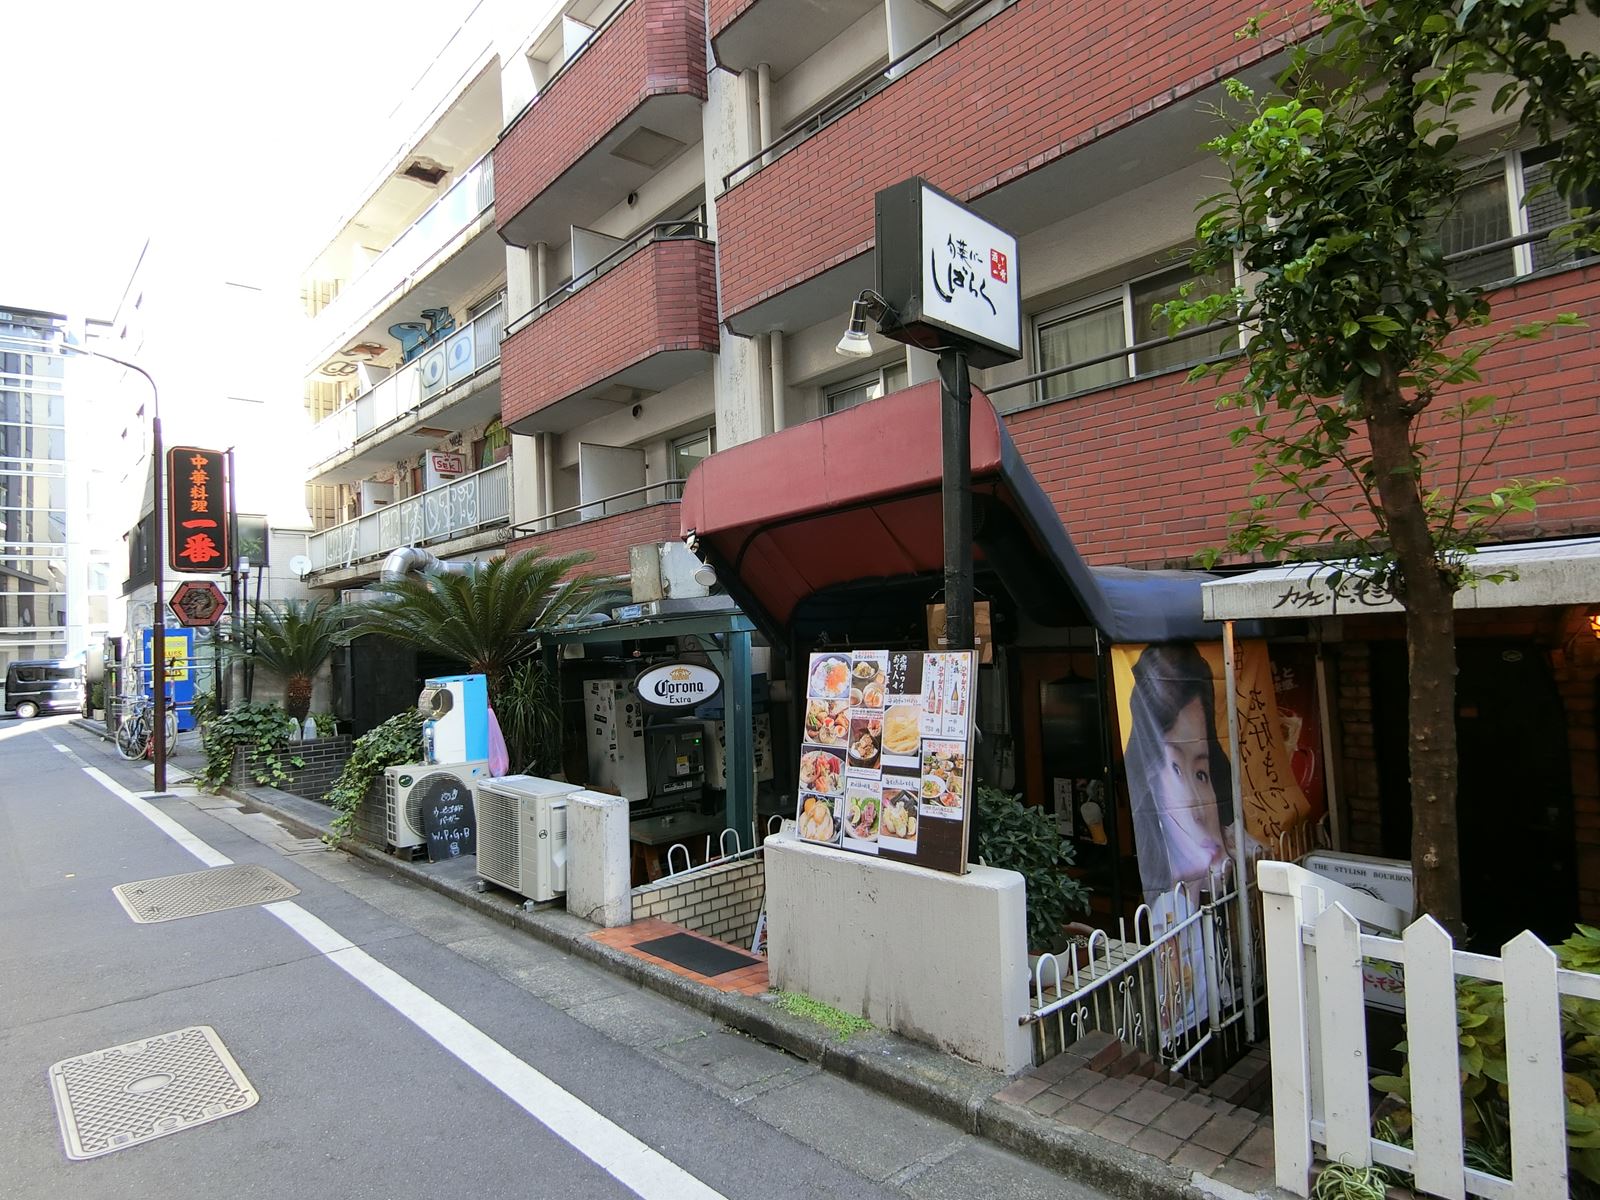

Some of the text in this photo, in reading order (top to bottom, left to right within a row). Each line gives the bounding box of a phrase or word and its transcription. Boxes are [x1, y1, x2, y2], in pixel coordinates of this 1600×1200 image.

[188, 453, 210, 513] 中華料理
[178, 518, 221, 563] 一番
[654, 679, 704, 698] Corona
[669, 696, 692, 704] Extra
[1313, 863, 1412, 883] THE STYLISH BOURBON
